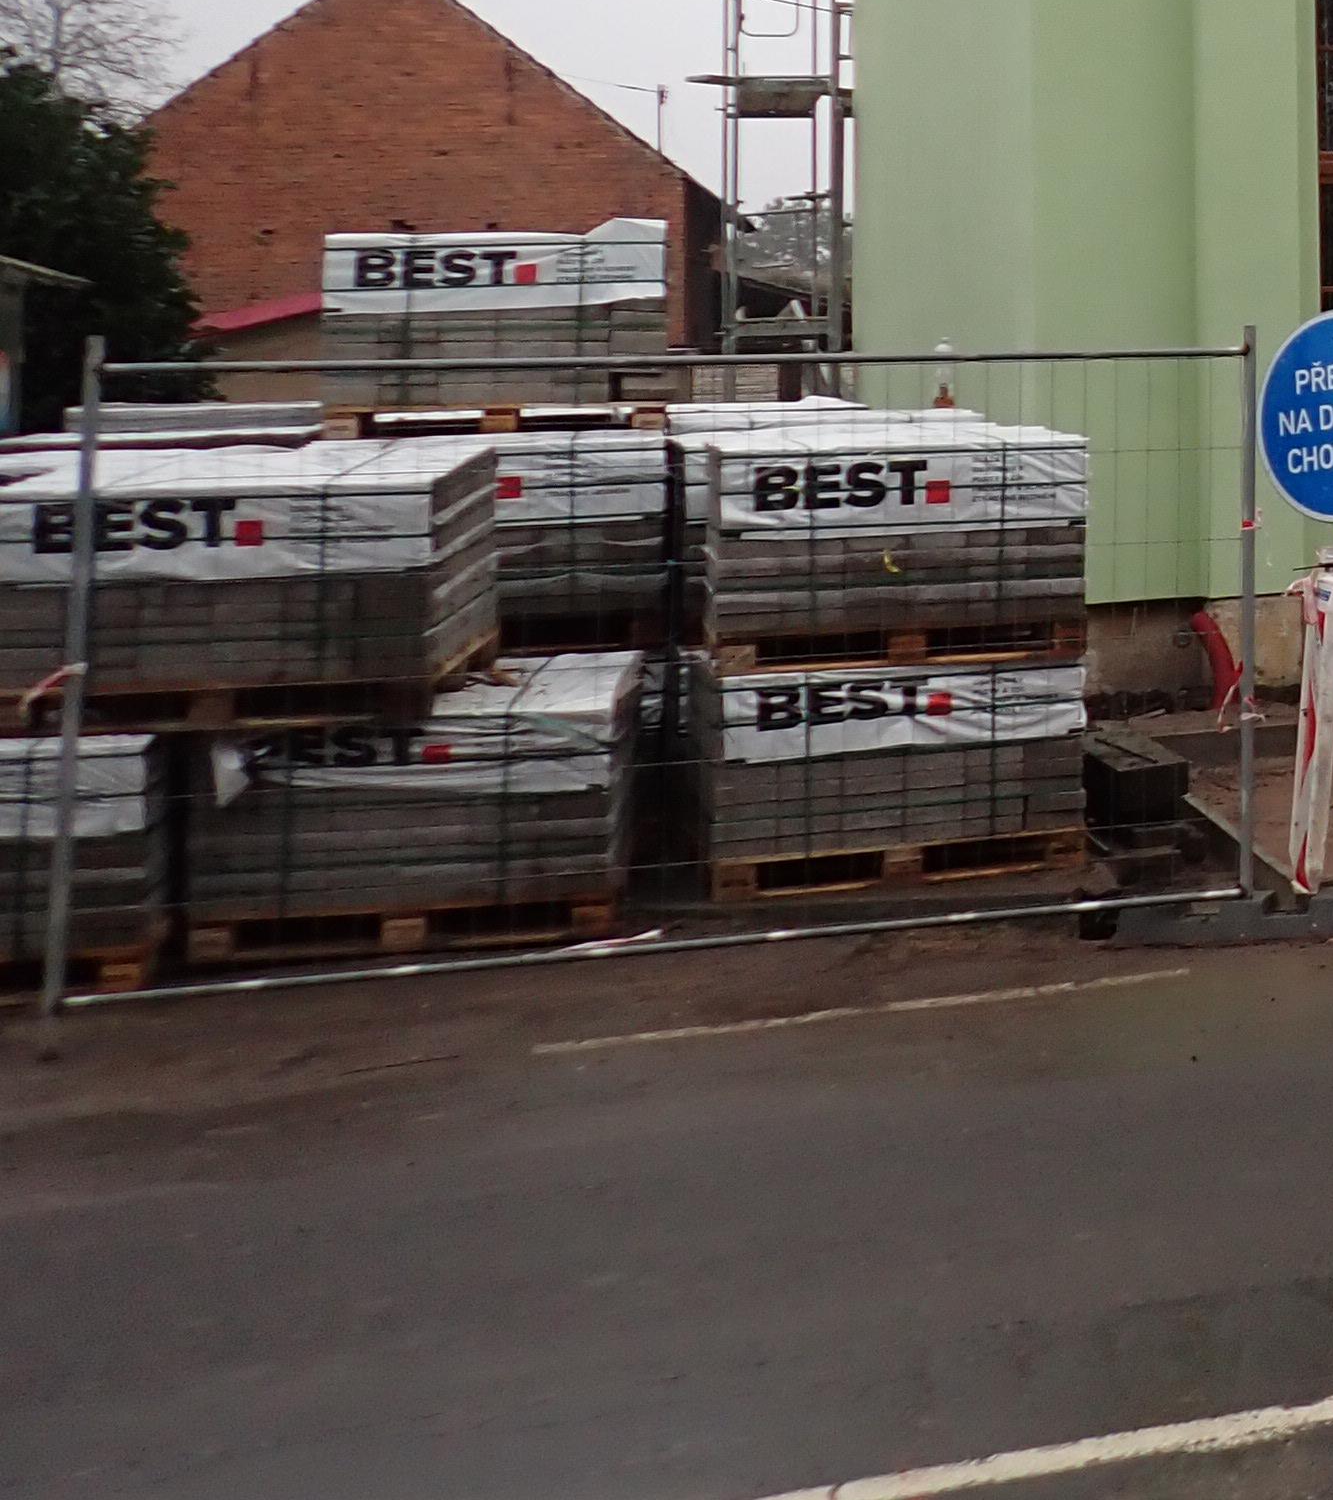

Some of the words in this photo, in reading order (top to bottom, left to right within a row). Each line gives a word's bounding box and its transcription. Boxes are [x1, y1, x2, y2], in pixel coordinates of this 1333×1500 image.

[355, 249, 517, 288] BEST
[1278, 408, 1313, 436] NA
[754, 459, 928, 512] BEST
[33, 499, 236, 554] BEST
